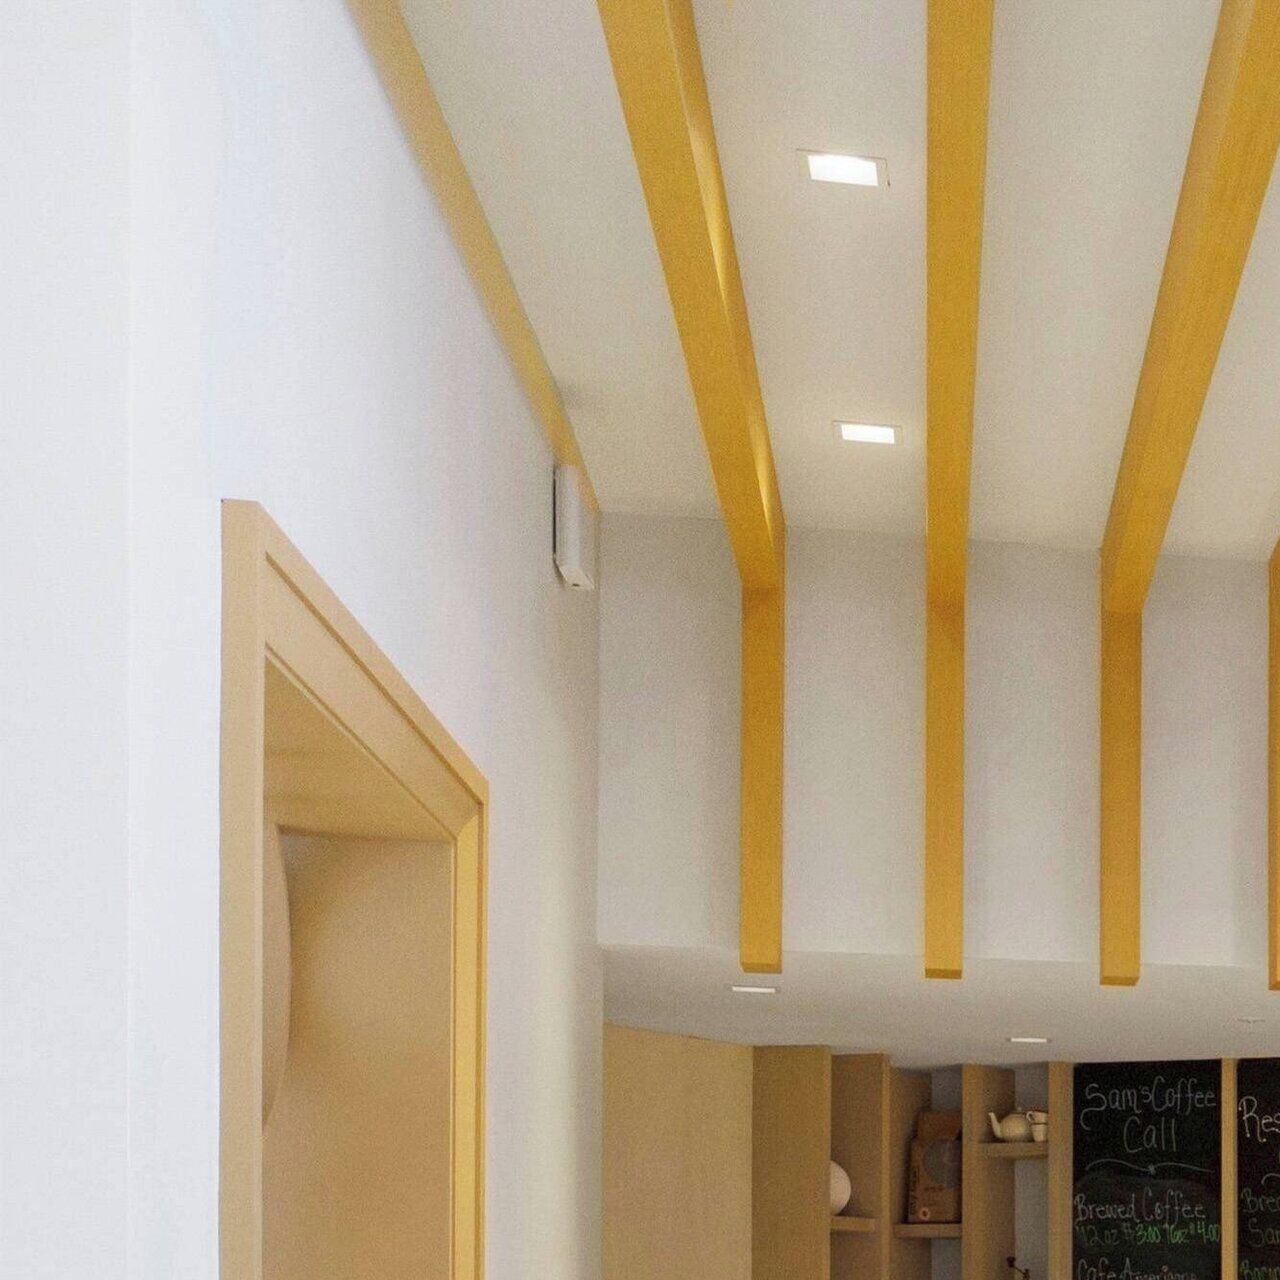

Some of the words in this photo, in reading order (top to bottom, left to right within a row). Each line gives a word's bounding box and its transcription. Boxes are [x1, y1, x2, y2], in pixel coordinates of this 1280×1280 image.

[1080, 1083, 1151, 1130] Sam's
[1151, 1075, 1217, 1115] Coffee
[1124, 1116, 1177, 1153] Call
[1075, 1193, 1142, 1223] Brewed
[1142, 1186, 1206, 1225] Coffee
